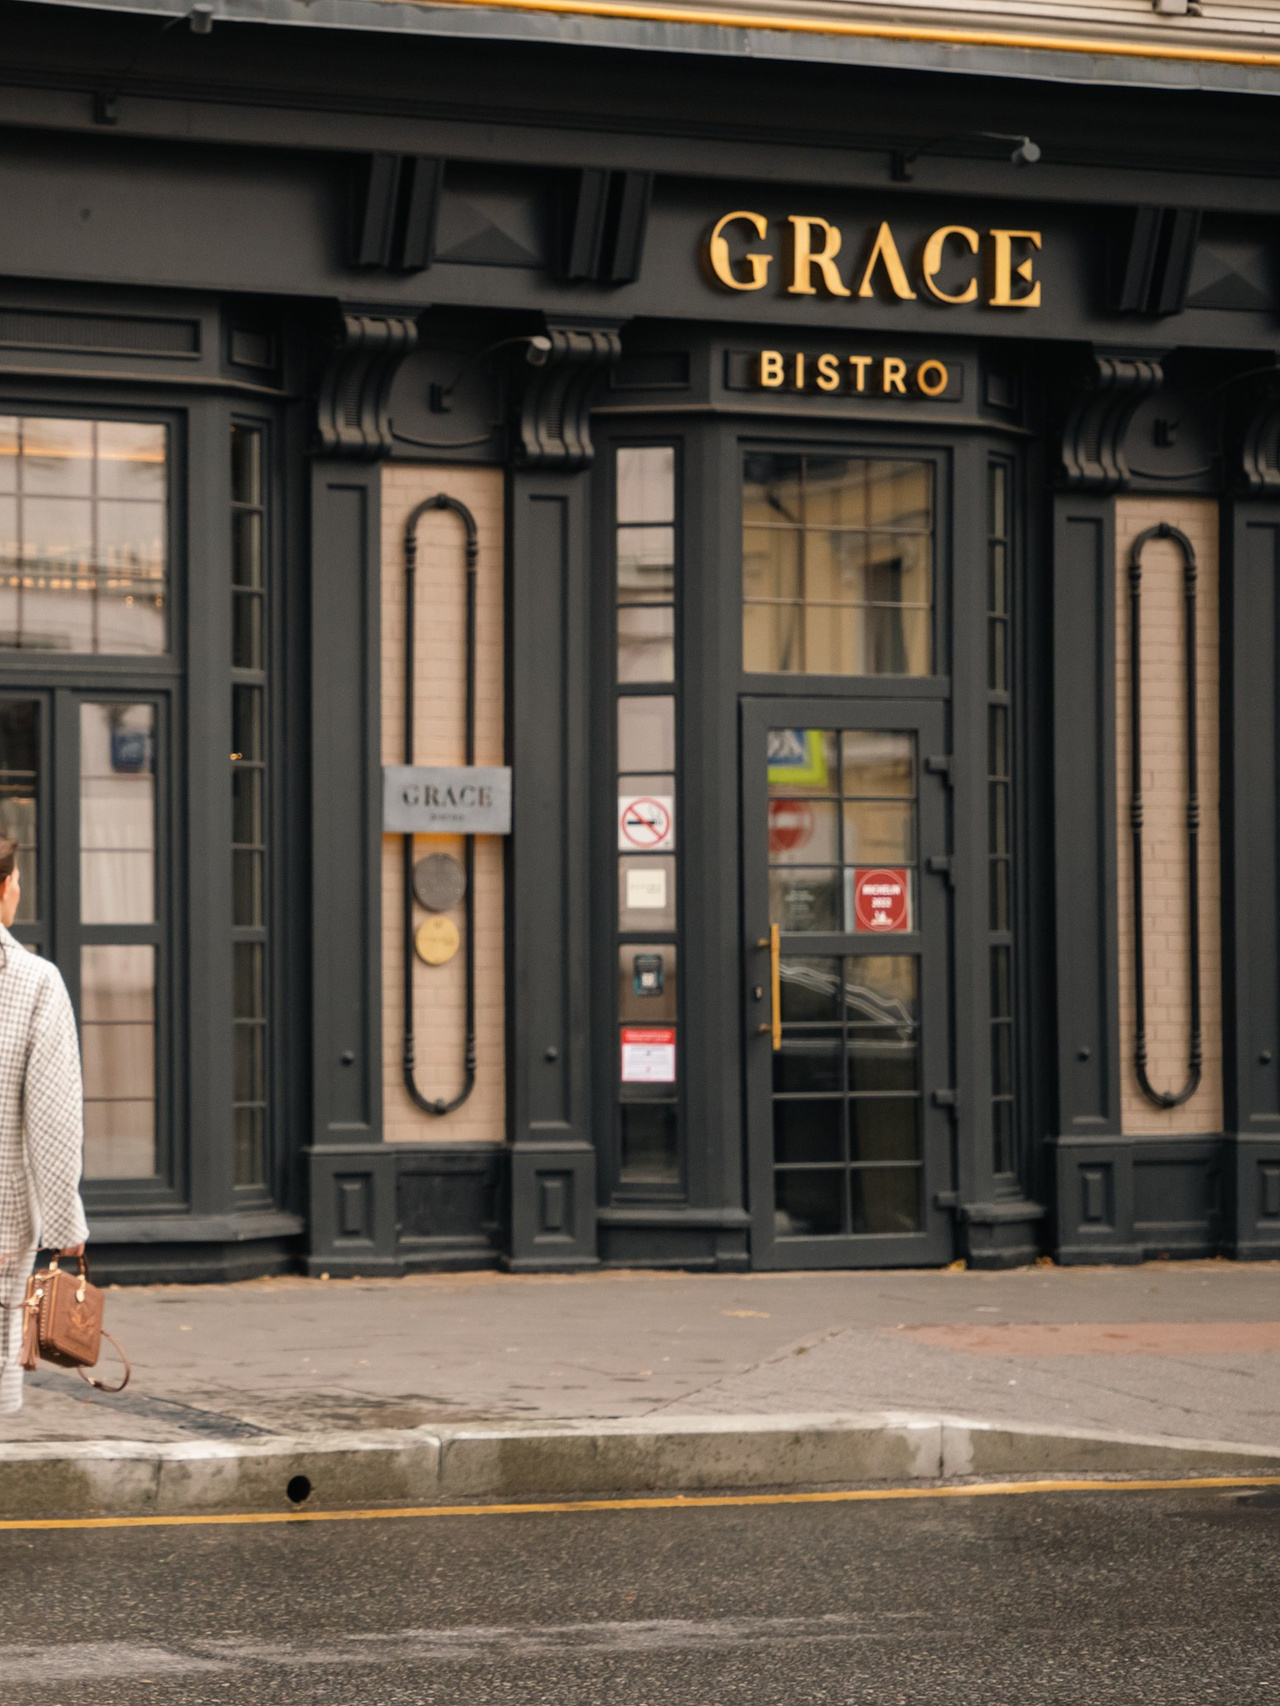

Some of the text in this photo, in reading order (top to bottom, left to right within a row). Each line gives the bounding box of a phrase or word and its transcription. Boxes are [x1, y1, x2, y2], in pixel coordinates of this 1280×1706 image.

[710, 211, 1042, 308] GRACE
[760, 350, 949, 397] BISTRO
[402, 784, 493, 808] GRACE
